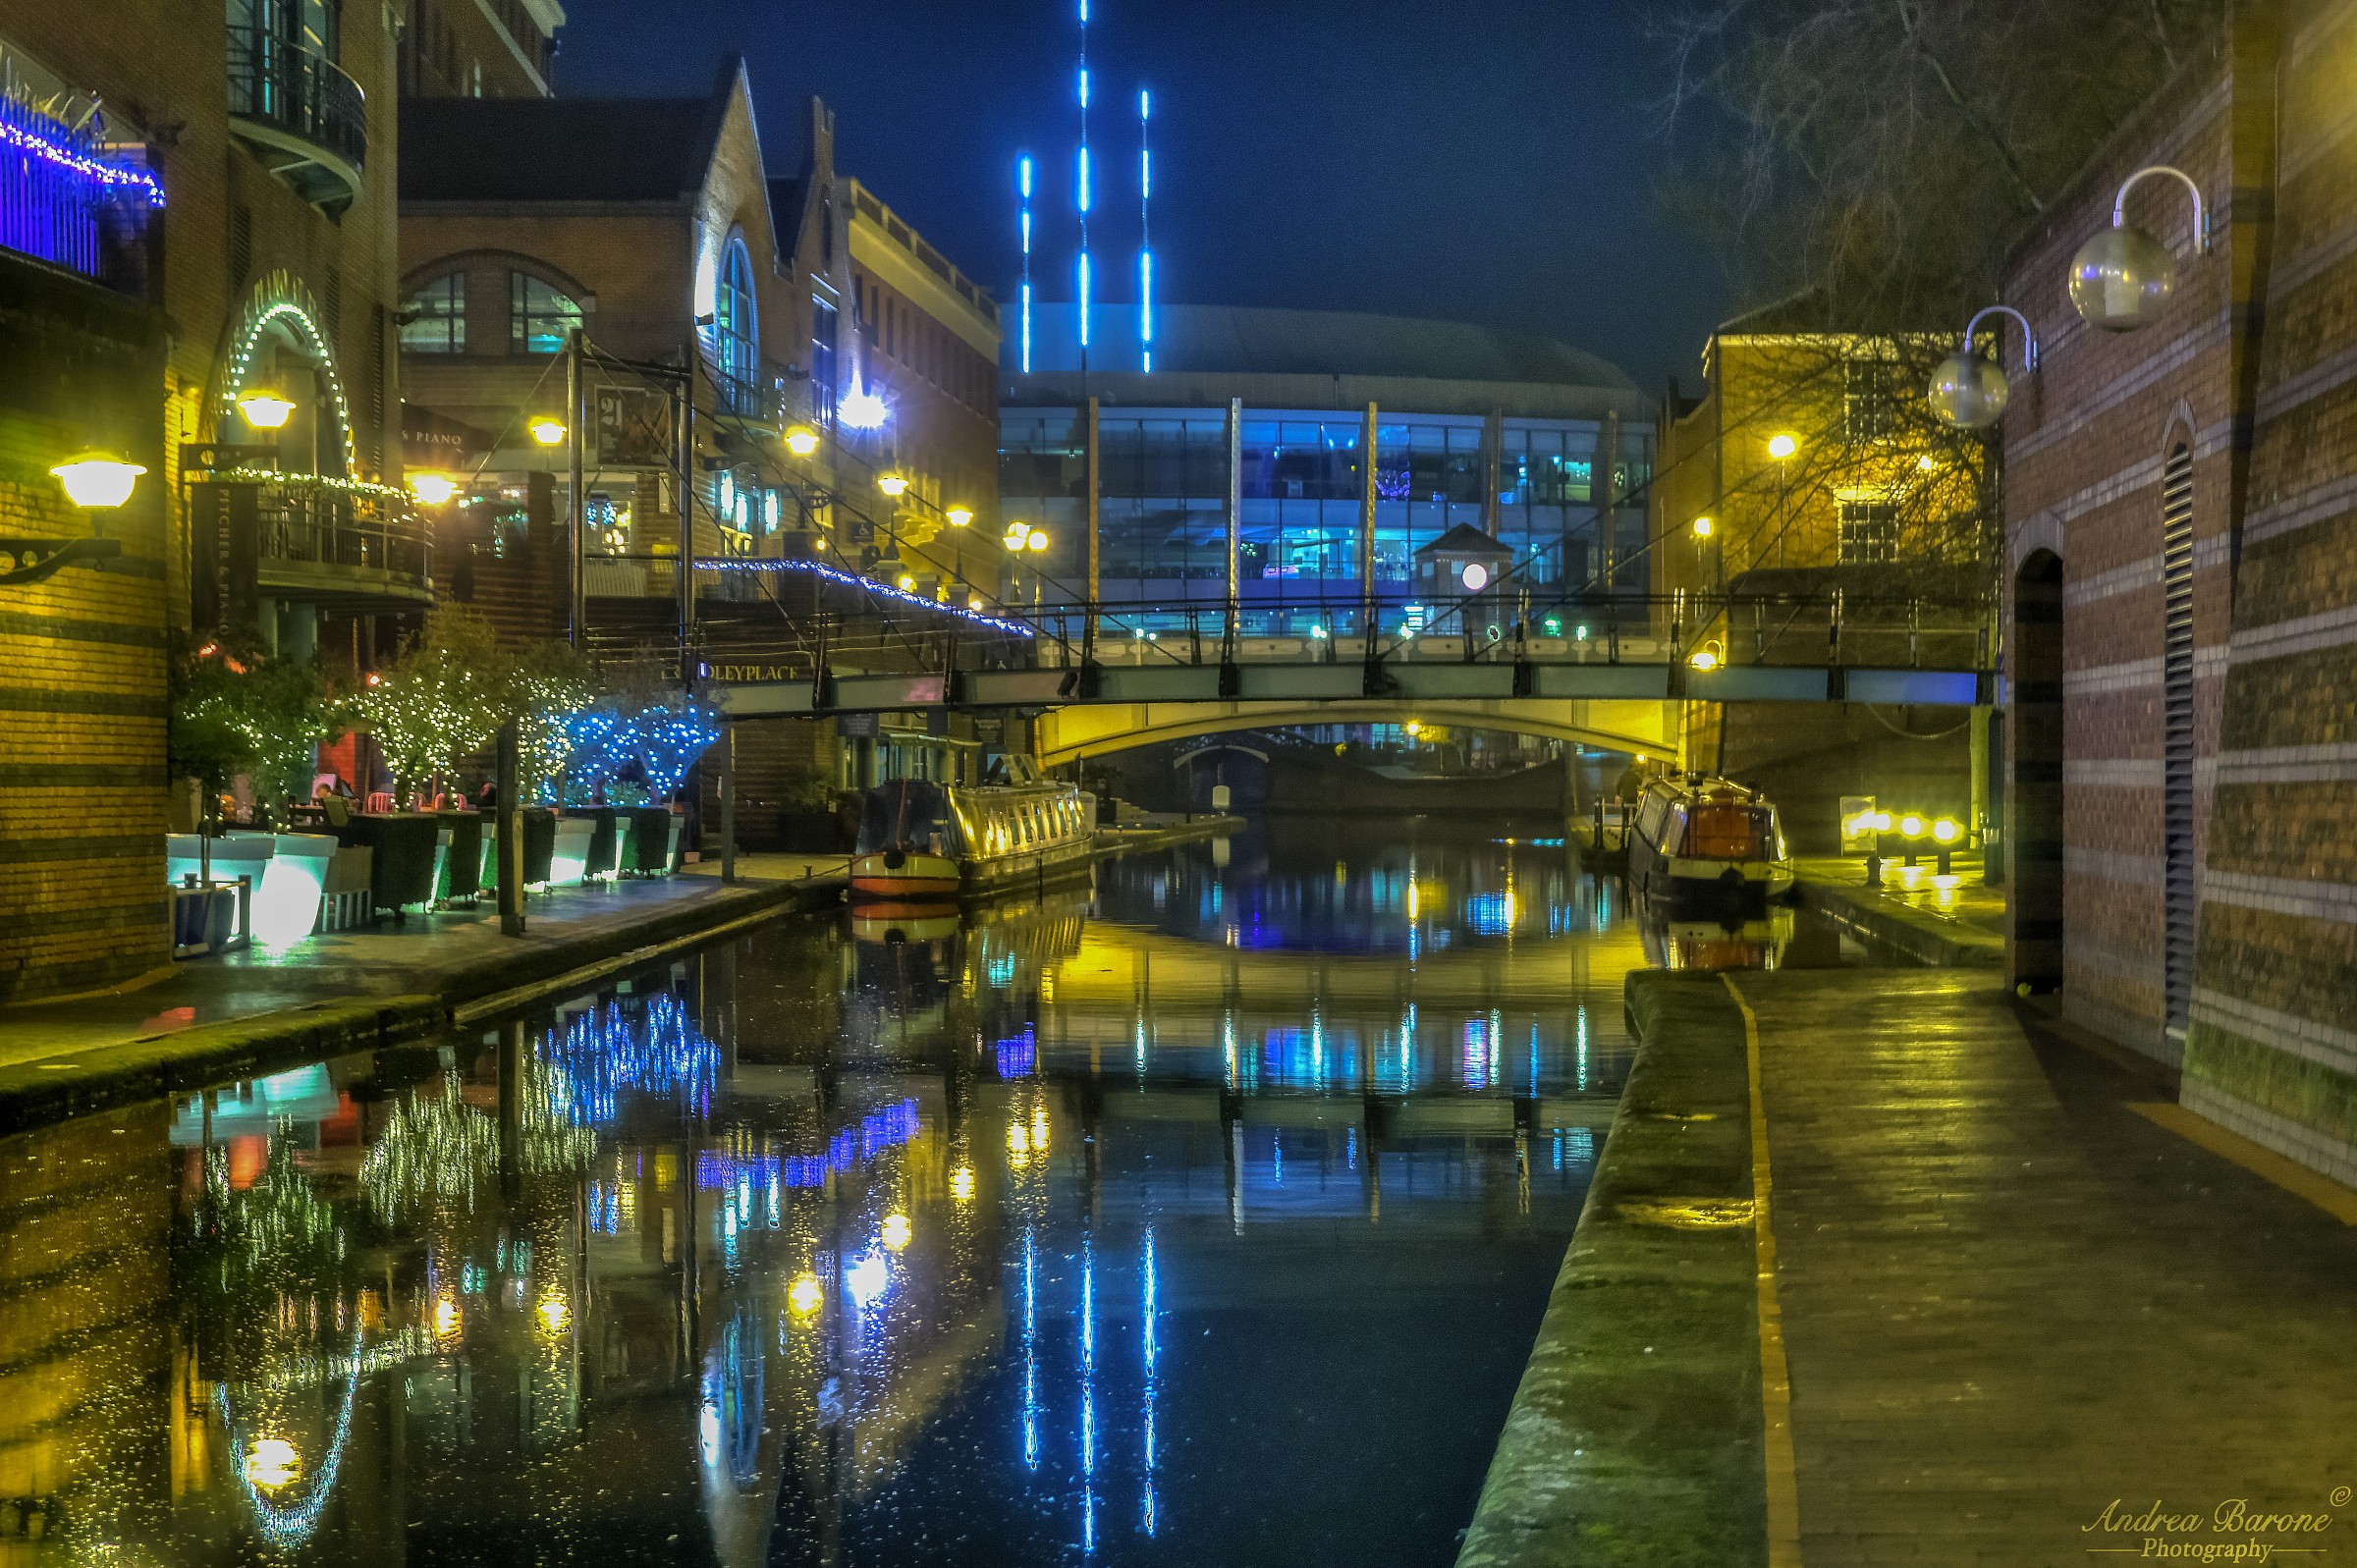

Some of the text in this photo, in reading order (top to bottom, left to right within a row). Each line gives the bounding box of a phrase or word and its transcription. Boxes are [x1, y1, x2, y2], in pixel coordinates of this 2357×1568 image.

[416, 431, 462, 445] PIANO
[218, 489, 230, 559] PITCHER
[218, 583, 229, 635] PIANO
